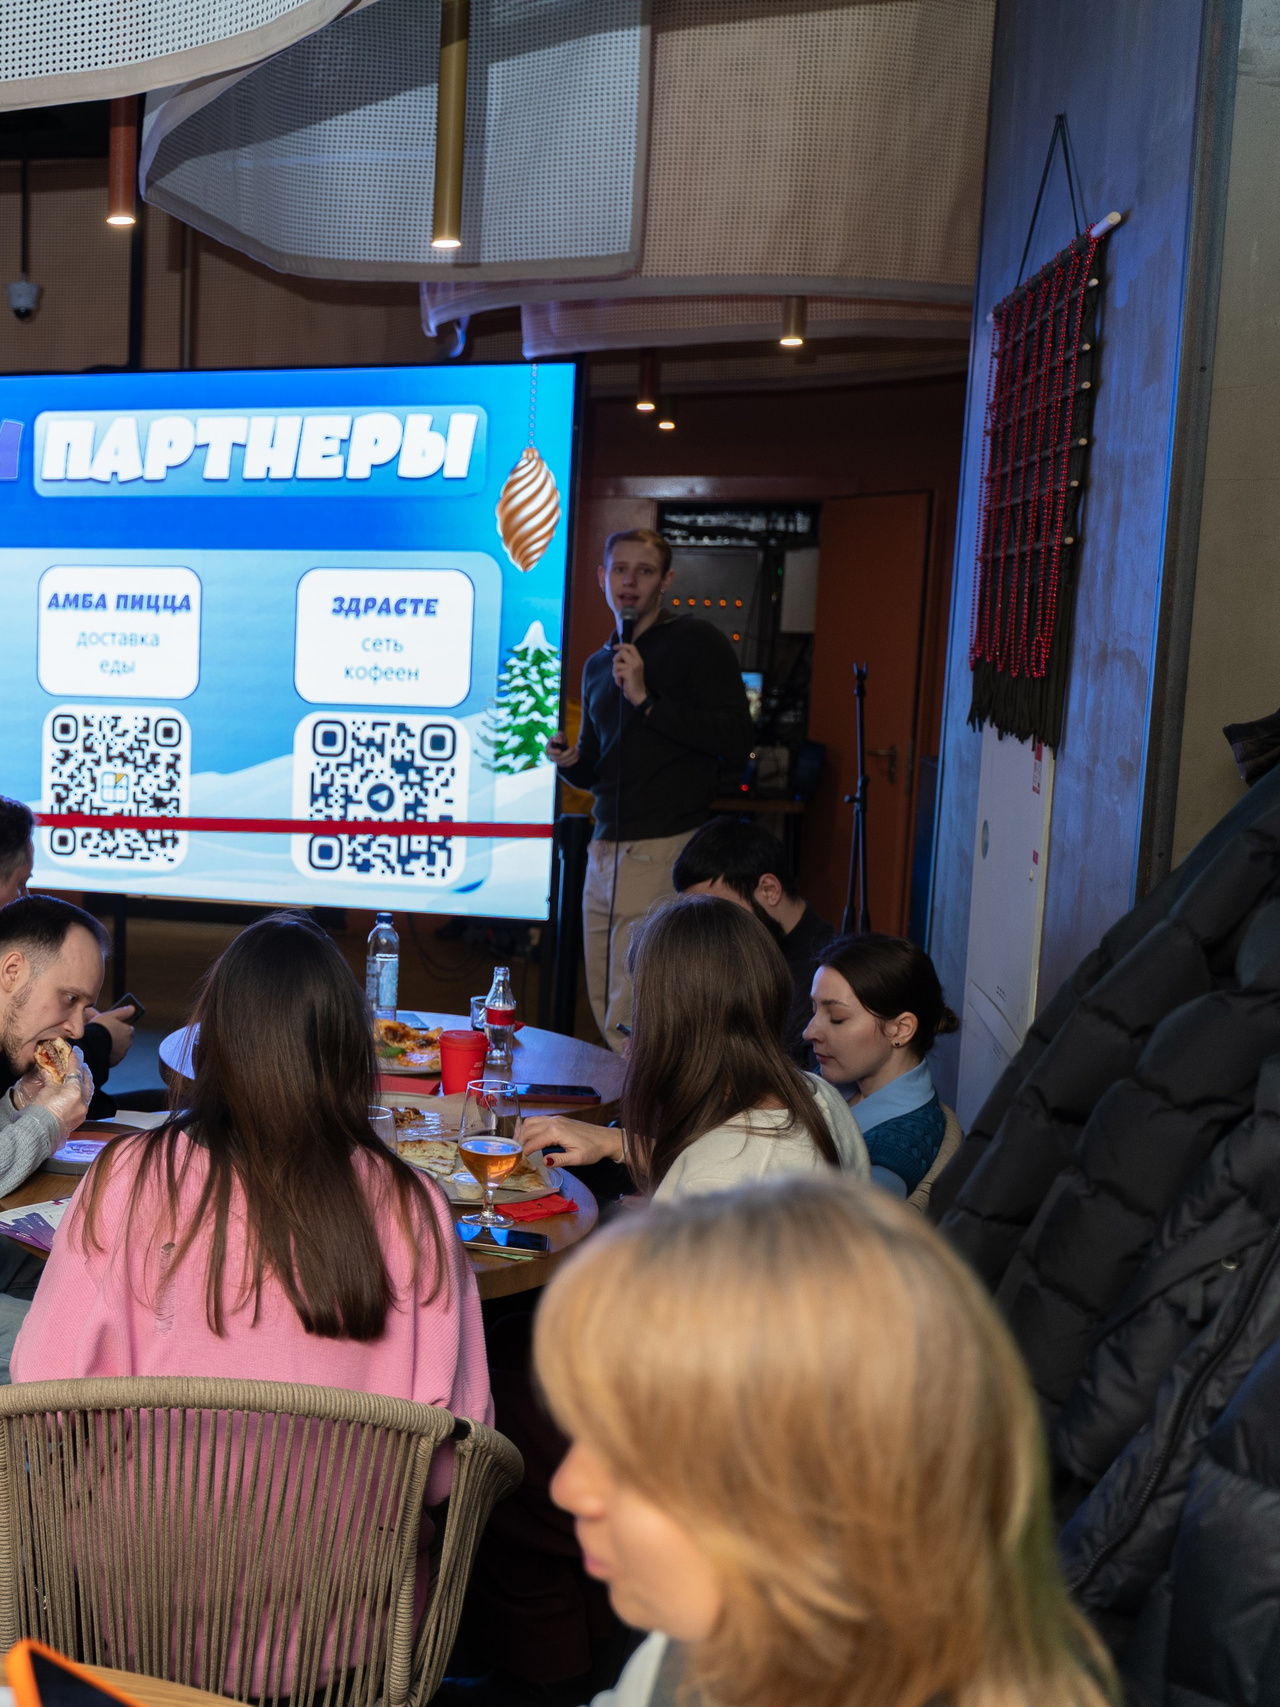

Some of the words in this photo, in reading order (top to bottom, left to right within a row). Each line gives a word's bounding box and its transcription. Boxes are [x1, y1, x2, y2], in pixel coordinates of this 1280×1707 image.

[40, 411, 479, 485] ПАРТНЕРЫ
[47, 592, 108, 611] АМБА
[115, 593, 192, 615] ПИЦЦА
[331, 596, 439, 619] ЗДРАСТЕ
[75, 631, 161, 648] доставка
[361, 637, 404, 653] сеть
[99, 659, 136, 676] еды
[344, 663, 420, 685] кофеен
